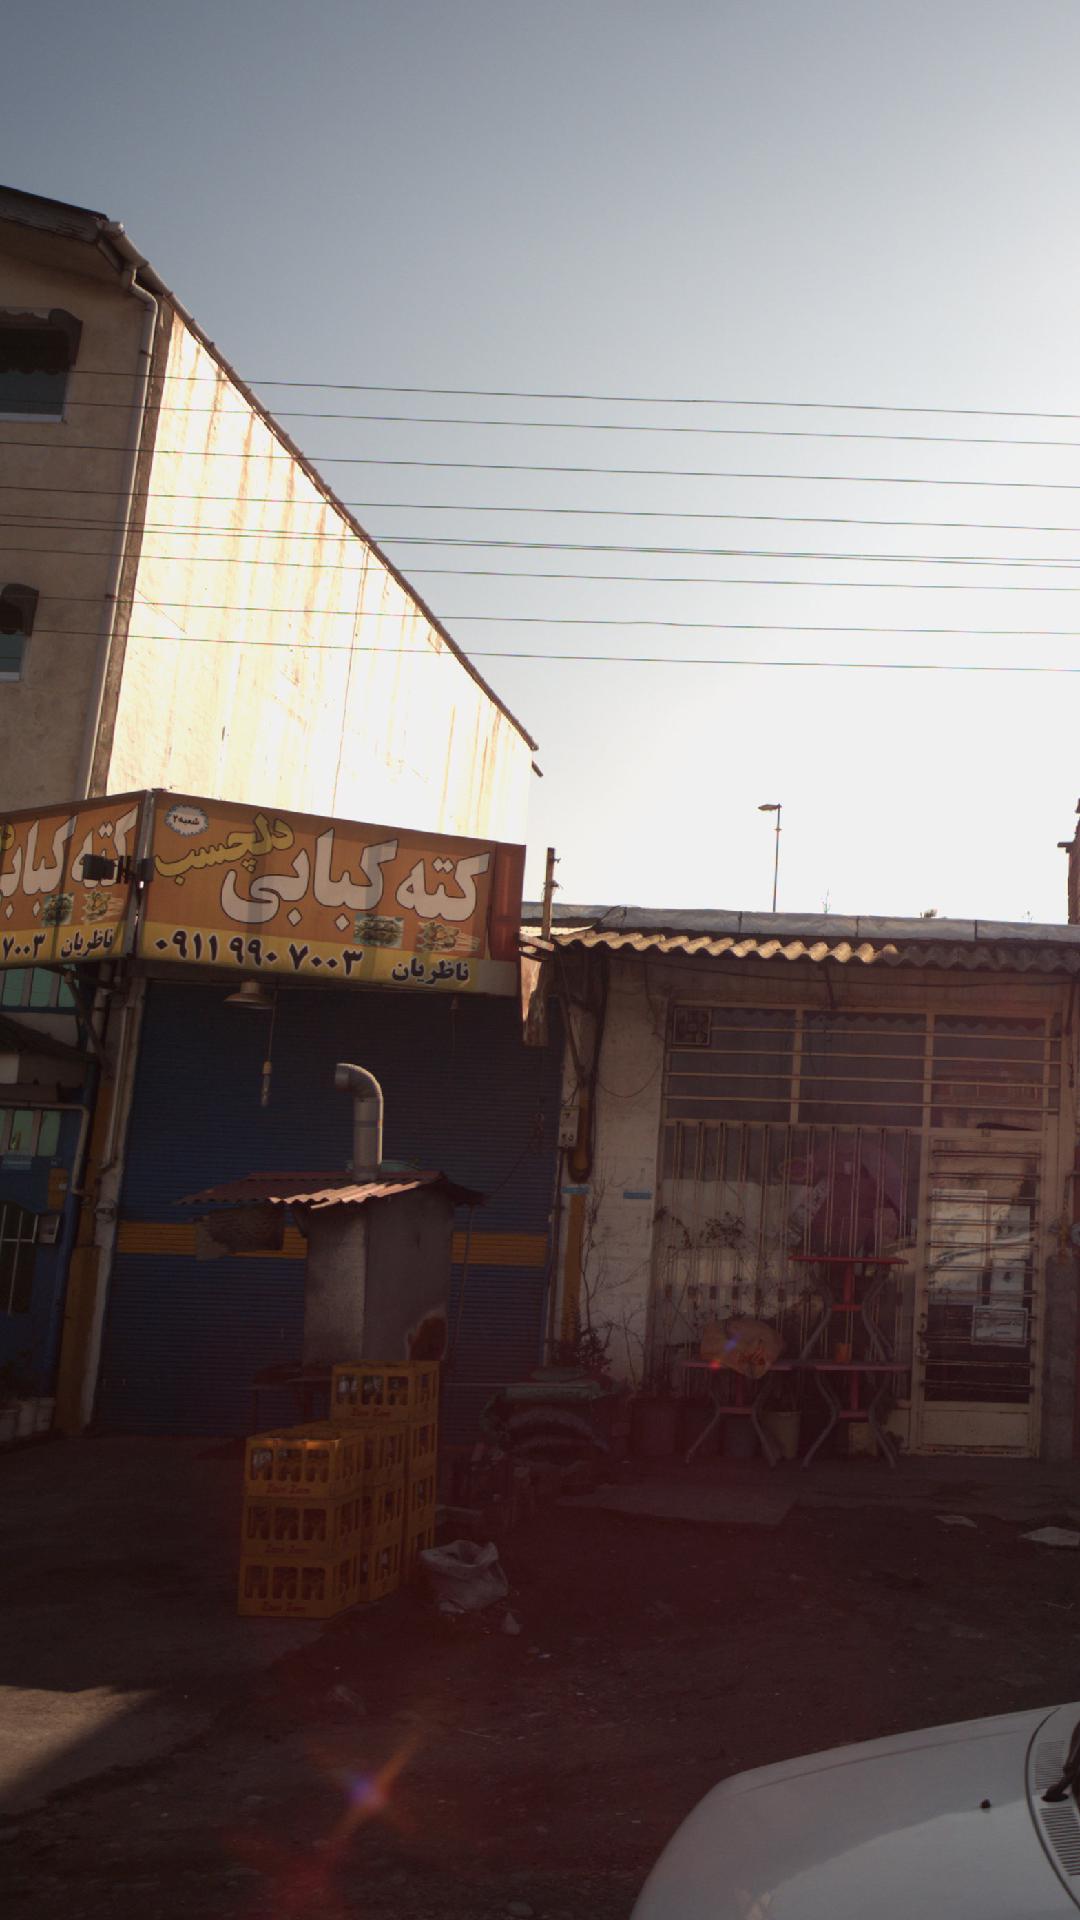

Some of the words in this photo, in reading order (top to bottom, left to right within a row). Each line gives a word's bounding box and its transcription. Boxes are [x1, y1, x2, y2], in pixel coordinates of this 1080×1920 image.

[0, 815, 77, 919] کباب
[154, 813, 295, 886] دلچسب
[220, 828, 398, 932] کبابی
[396, 853, 490, 921] کته
[60, 928, 114, 958] ناظریان
[391, 957, 470, 985] ناظریان
